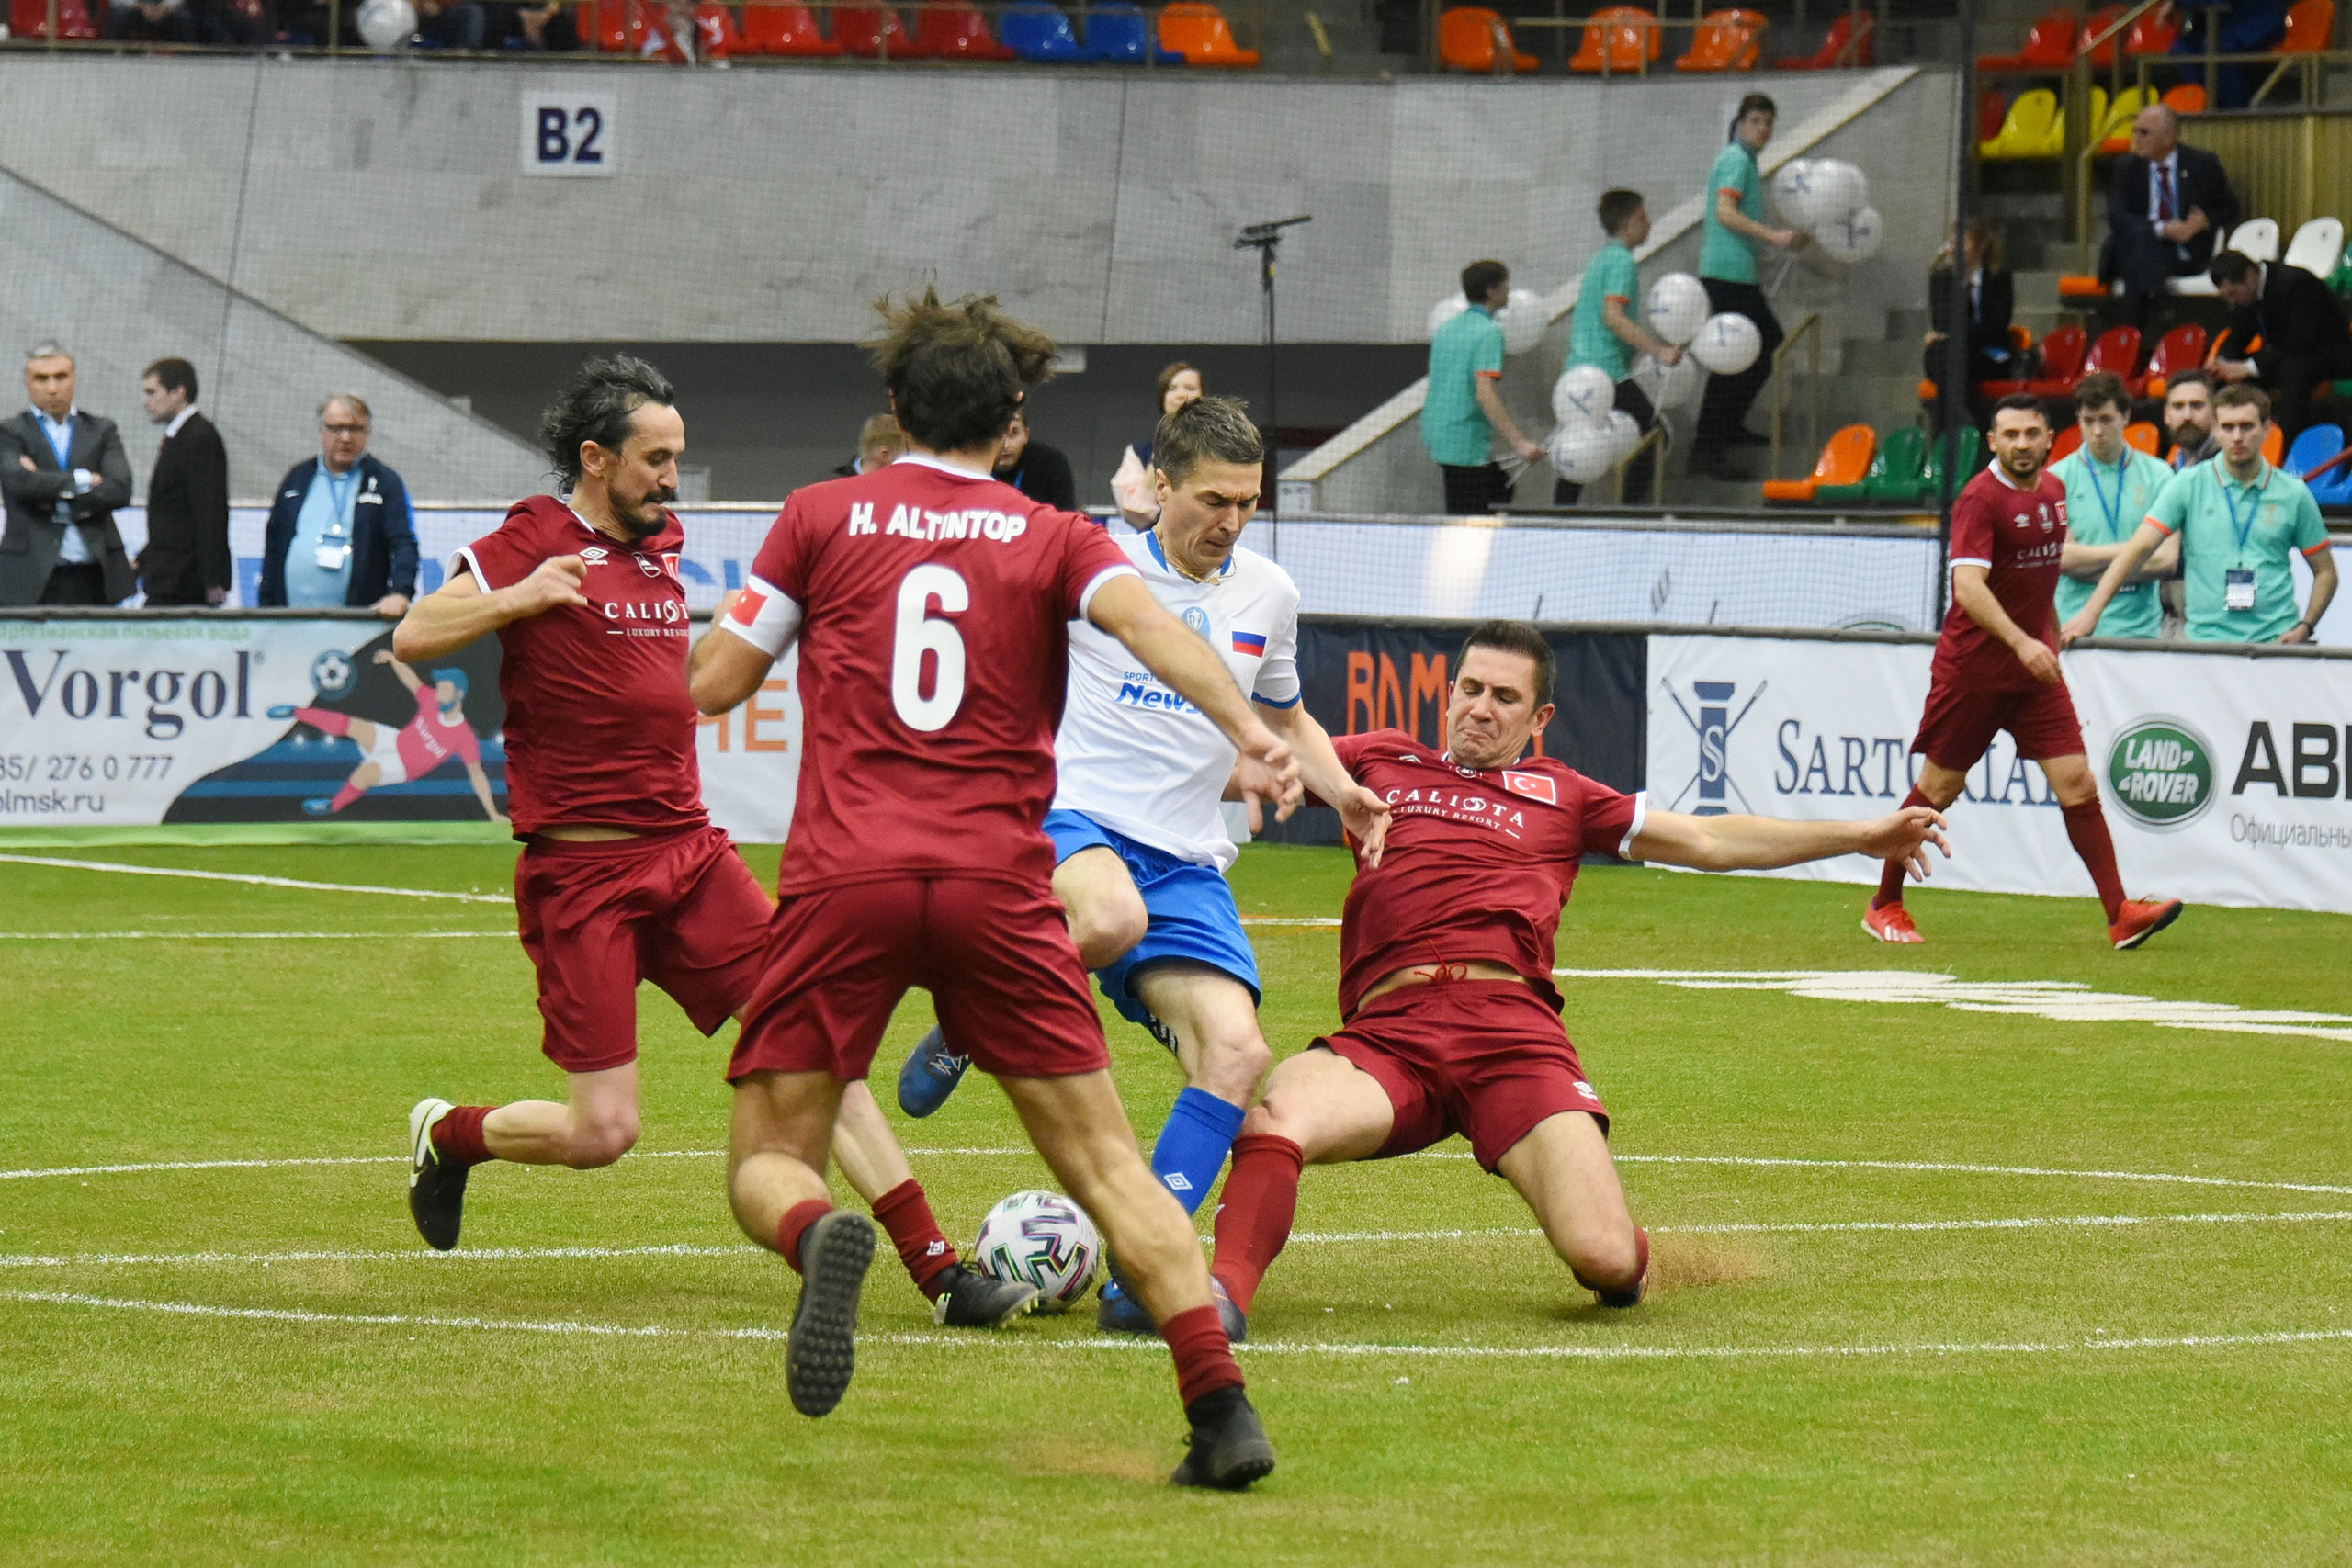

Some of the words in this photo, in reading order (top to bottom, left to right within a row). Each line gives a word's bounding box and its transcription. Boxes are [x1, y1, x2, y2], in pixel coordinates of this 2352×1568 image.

[537, 107, 602, 162] B2
[849, 502, 878, 536] H.
[885, 502, 1026, 544] ALTINTOP
[626, 627, 661, 637] LUXURY
[892, 563, 970, 732] 6
[3, 649, 254, 740] Vorgol
[47, 755, 94, 781] 276
[103, 754, 119, 780] 0
[127, 753, 174, 780] 777
[2125, 738, 2182, 771] LAND
[2129, 772, 2199, 804] ROVER
[1453, 812, 1501, 829] RESORT
